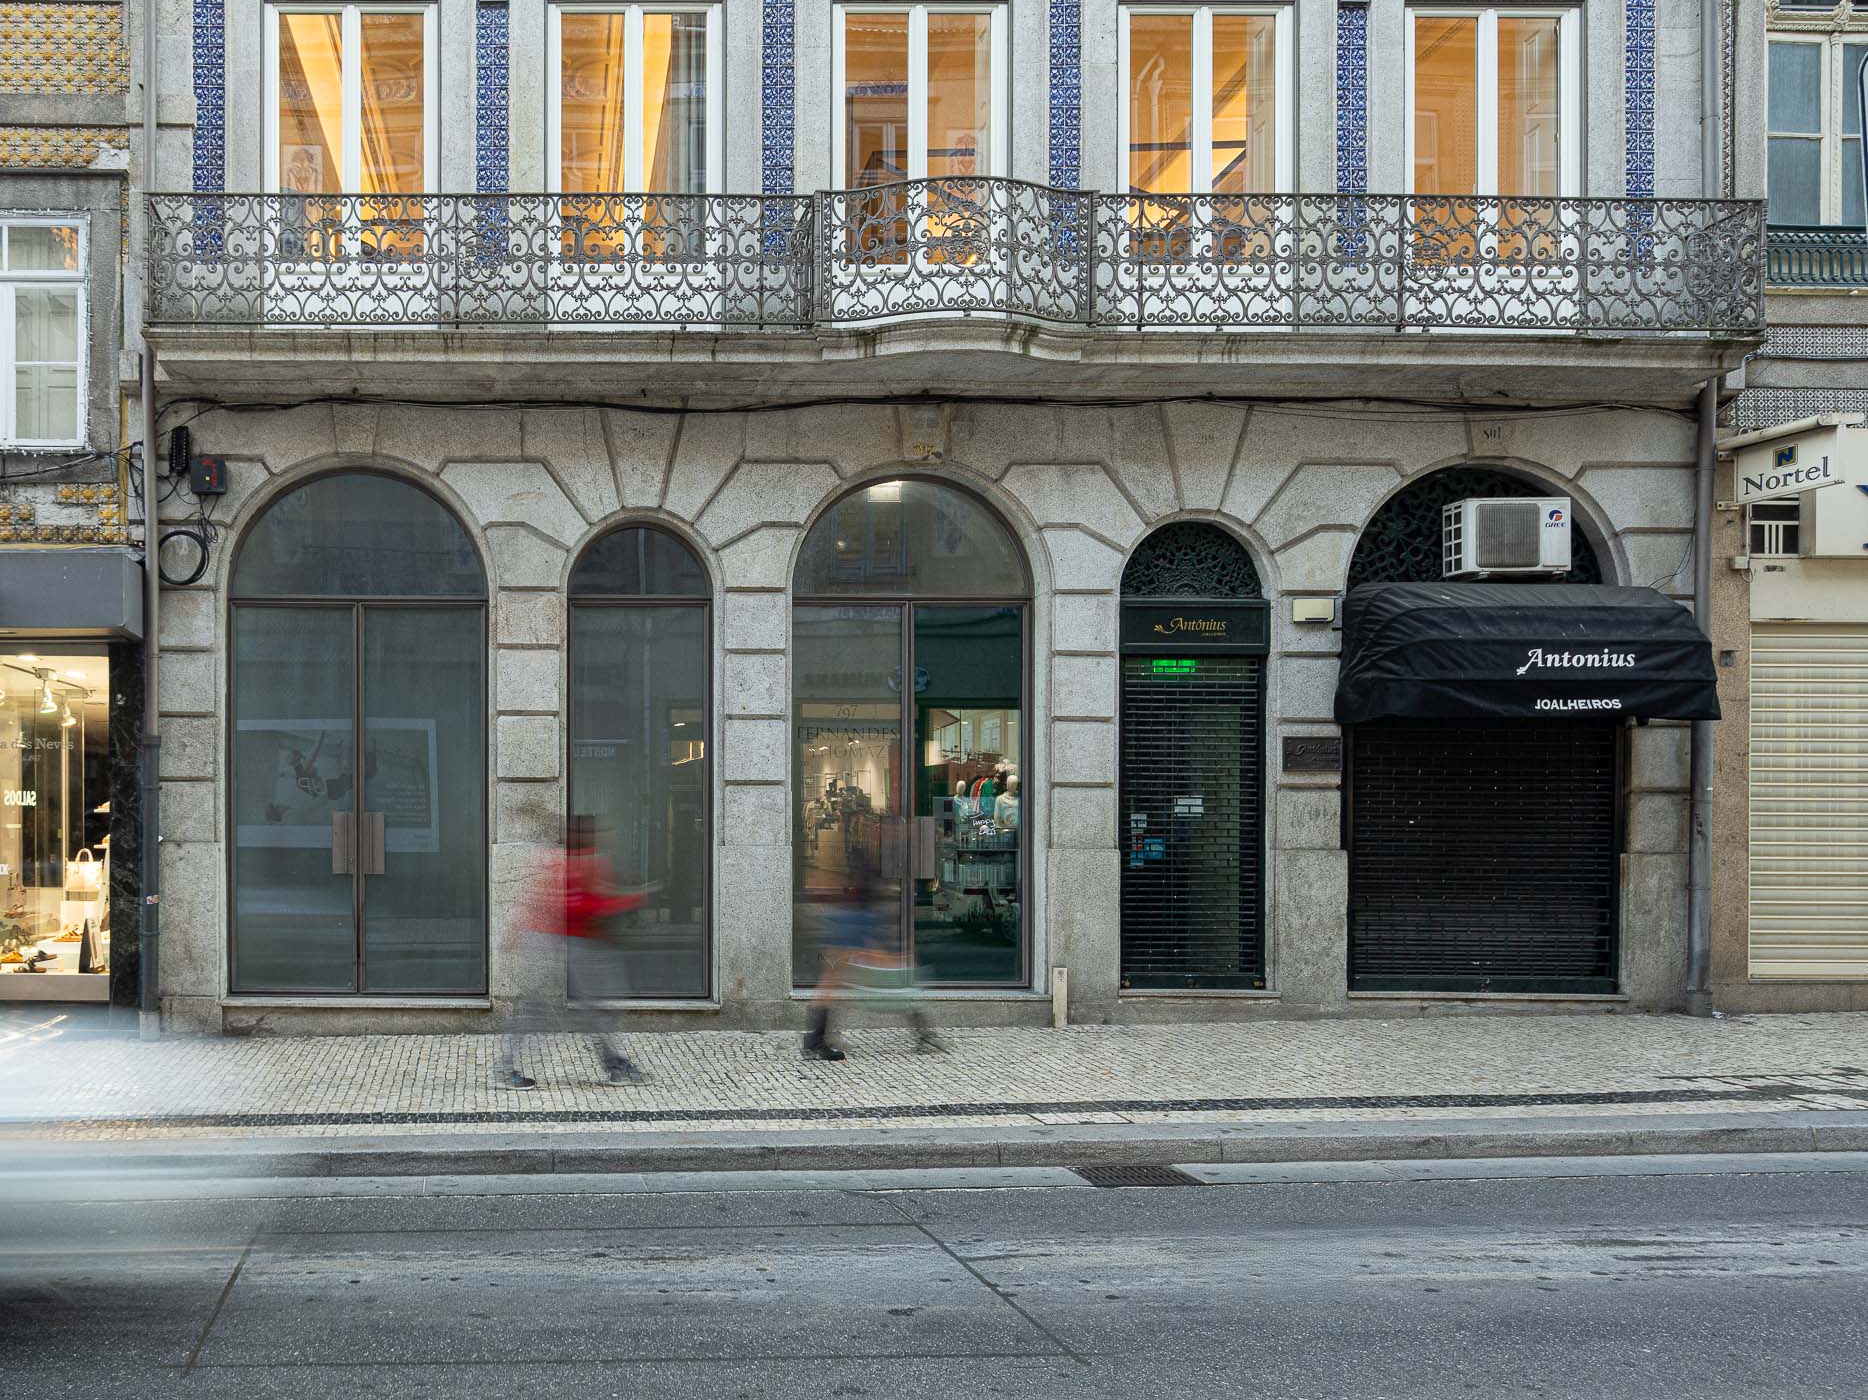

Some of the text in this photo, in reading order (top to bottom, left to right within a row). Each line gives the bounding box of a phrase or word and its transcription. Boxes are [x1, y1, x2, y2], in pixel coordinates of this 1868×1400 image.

[1742, 456, 1831, 495] Nortel
[1166, 617, 1228, 633] Antónius
[1517, 648, 1636, 675] Antonius
[1534, 698, 1622, 710] JOALHEIROS
[797, 727, 898, 740] FERNANDES
